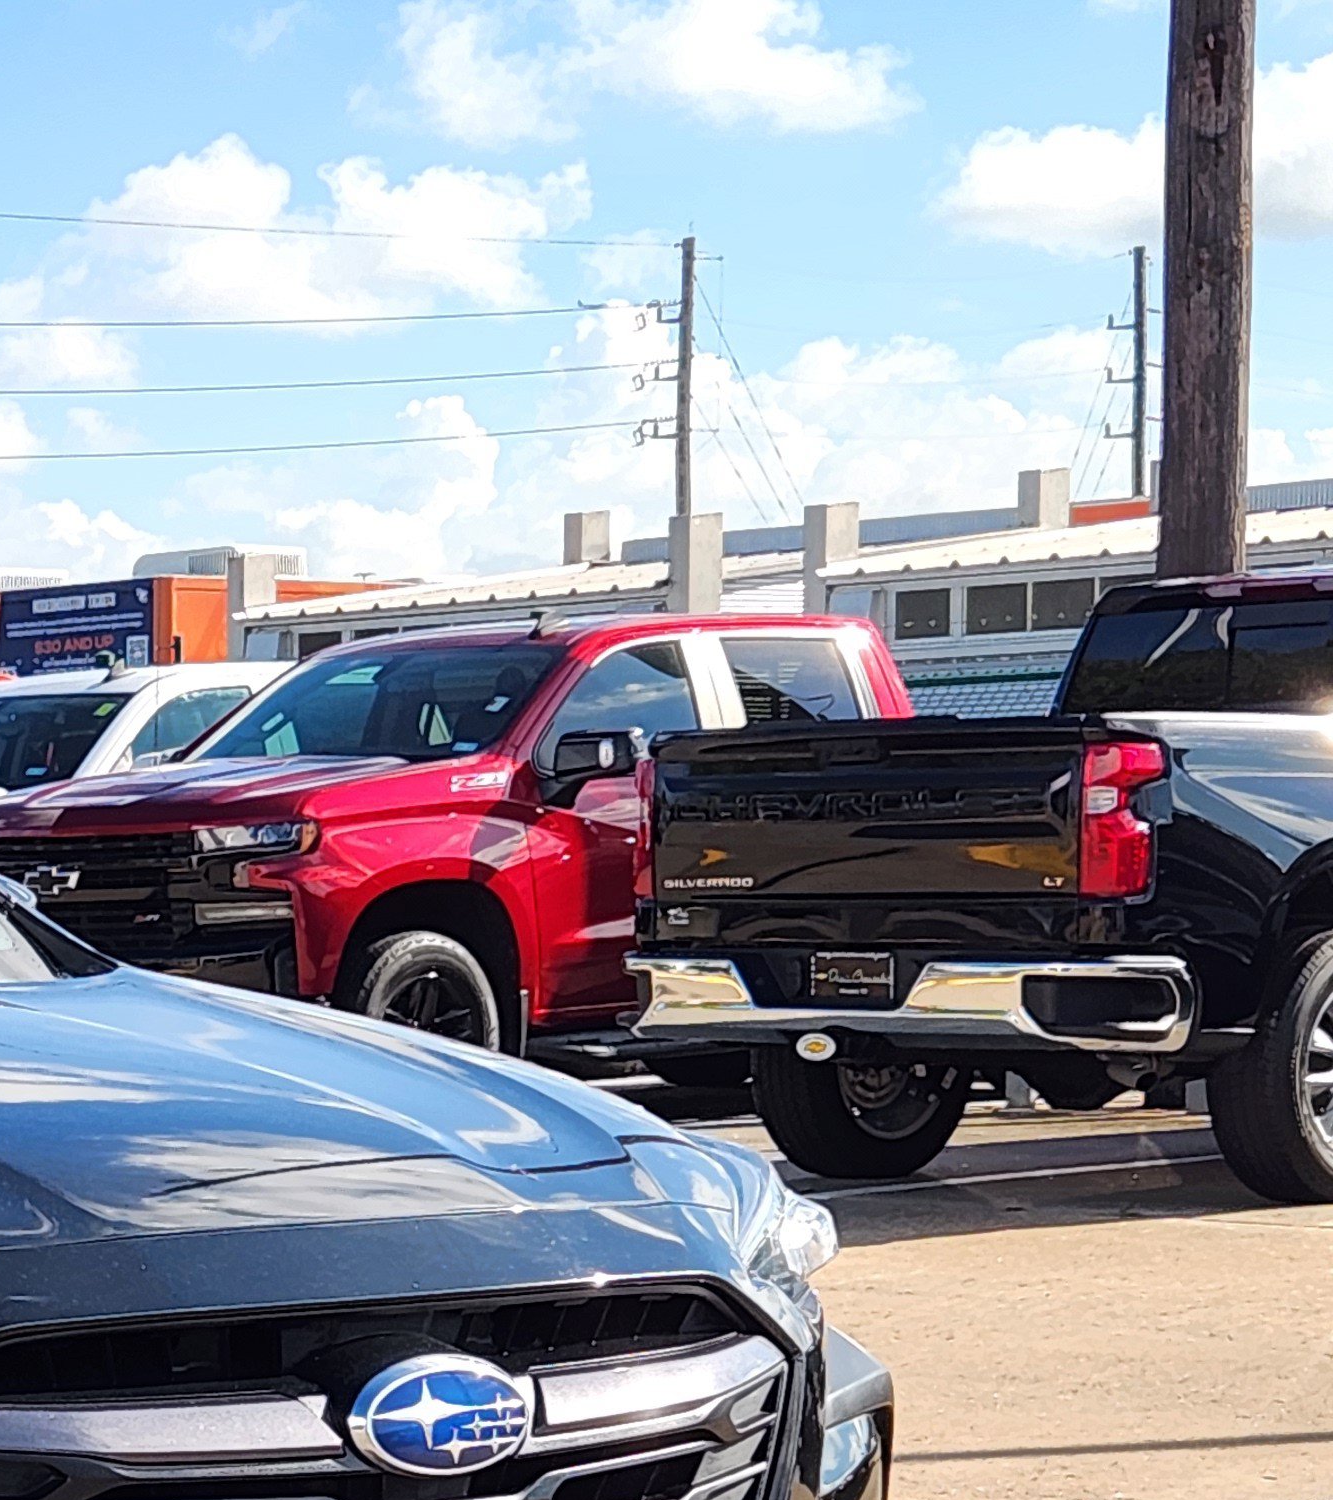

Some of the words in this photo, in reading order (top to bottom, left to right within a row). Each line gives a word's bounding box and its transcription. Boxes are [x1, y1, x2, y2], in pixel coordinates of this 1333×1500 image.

[64, 637, 93, 652] AND
[94, 633, 115, 648] UP
[1043, 876, 1065, 887] LT
